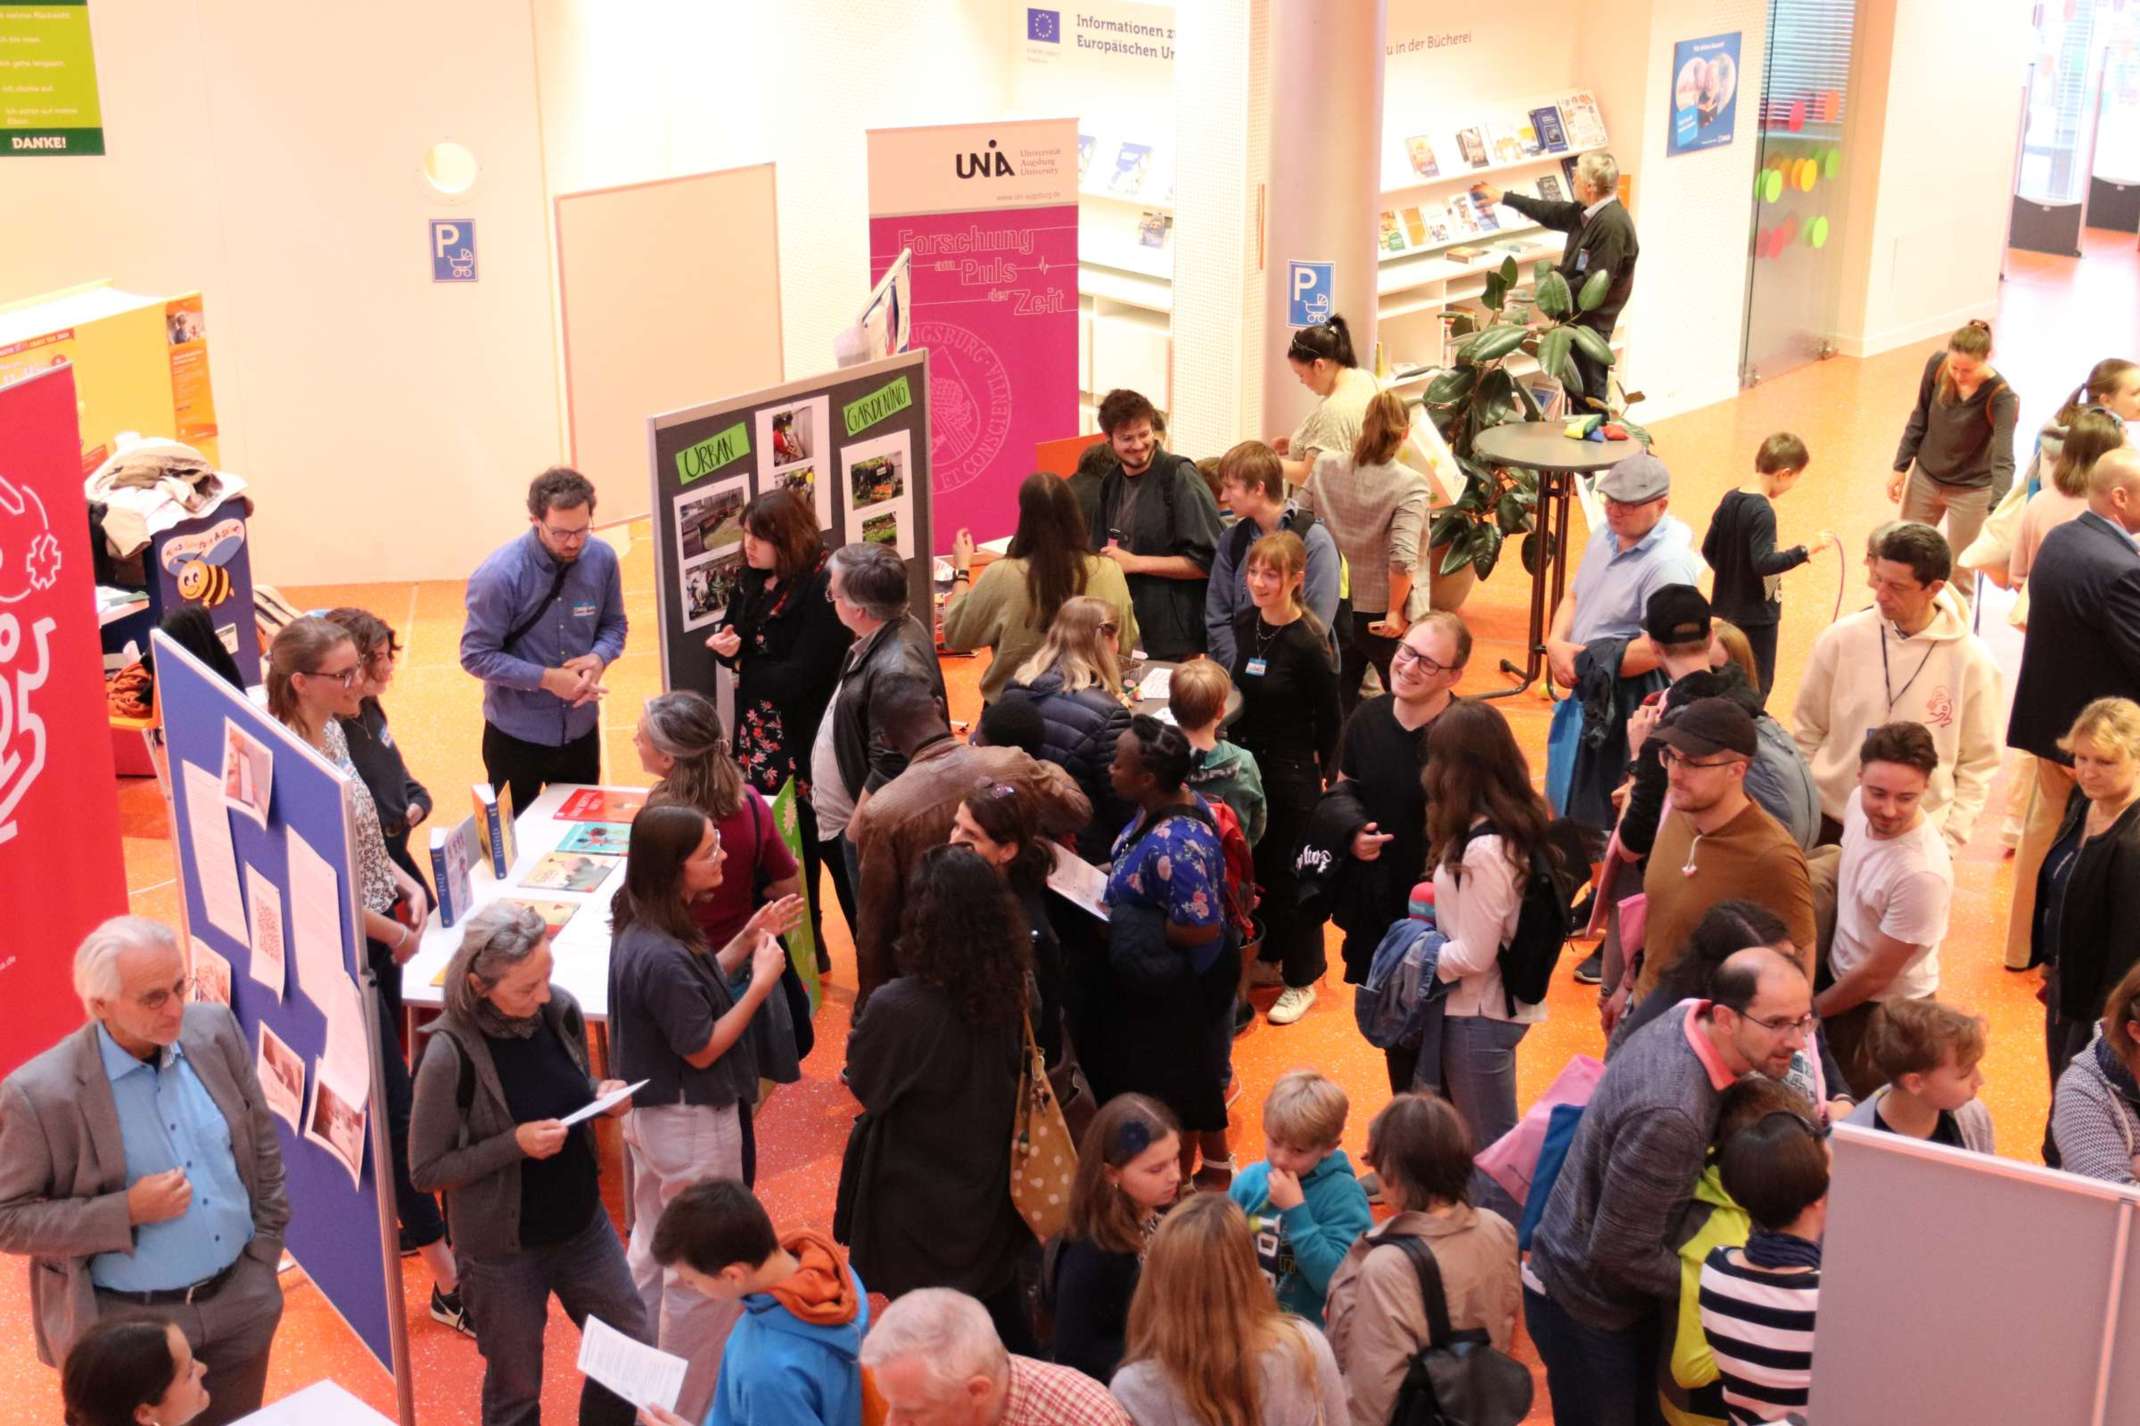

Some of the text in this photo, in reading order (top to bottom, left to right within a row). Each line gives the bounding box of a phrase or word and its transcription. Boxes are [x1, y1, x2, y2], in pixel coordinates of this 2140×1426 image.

[1077, 14, 1164, 38] Informationen
[1077, 35, 1158, 59] Europäischen
[1396, 41, 1407, 56] in
[1408, 38, 1425, 53] der
[1427, 31, 1472, 49] Bücherei
[12, 136, 67, 149] DANKE!
[436, 224, 460, 258] P
[898, 225, 1034, 256] Forschung
[934, 256, 1018, 286] am Puls
[1294, 267, 1317, 301] P
[987, 287, 1065, 316] der Zeit
[847, 378, 907, 432] GARDENING
[684, 437, 735, 478] URBAN
